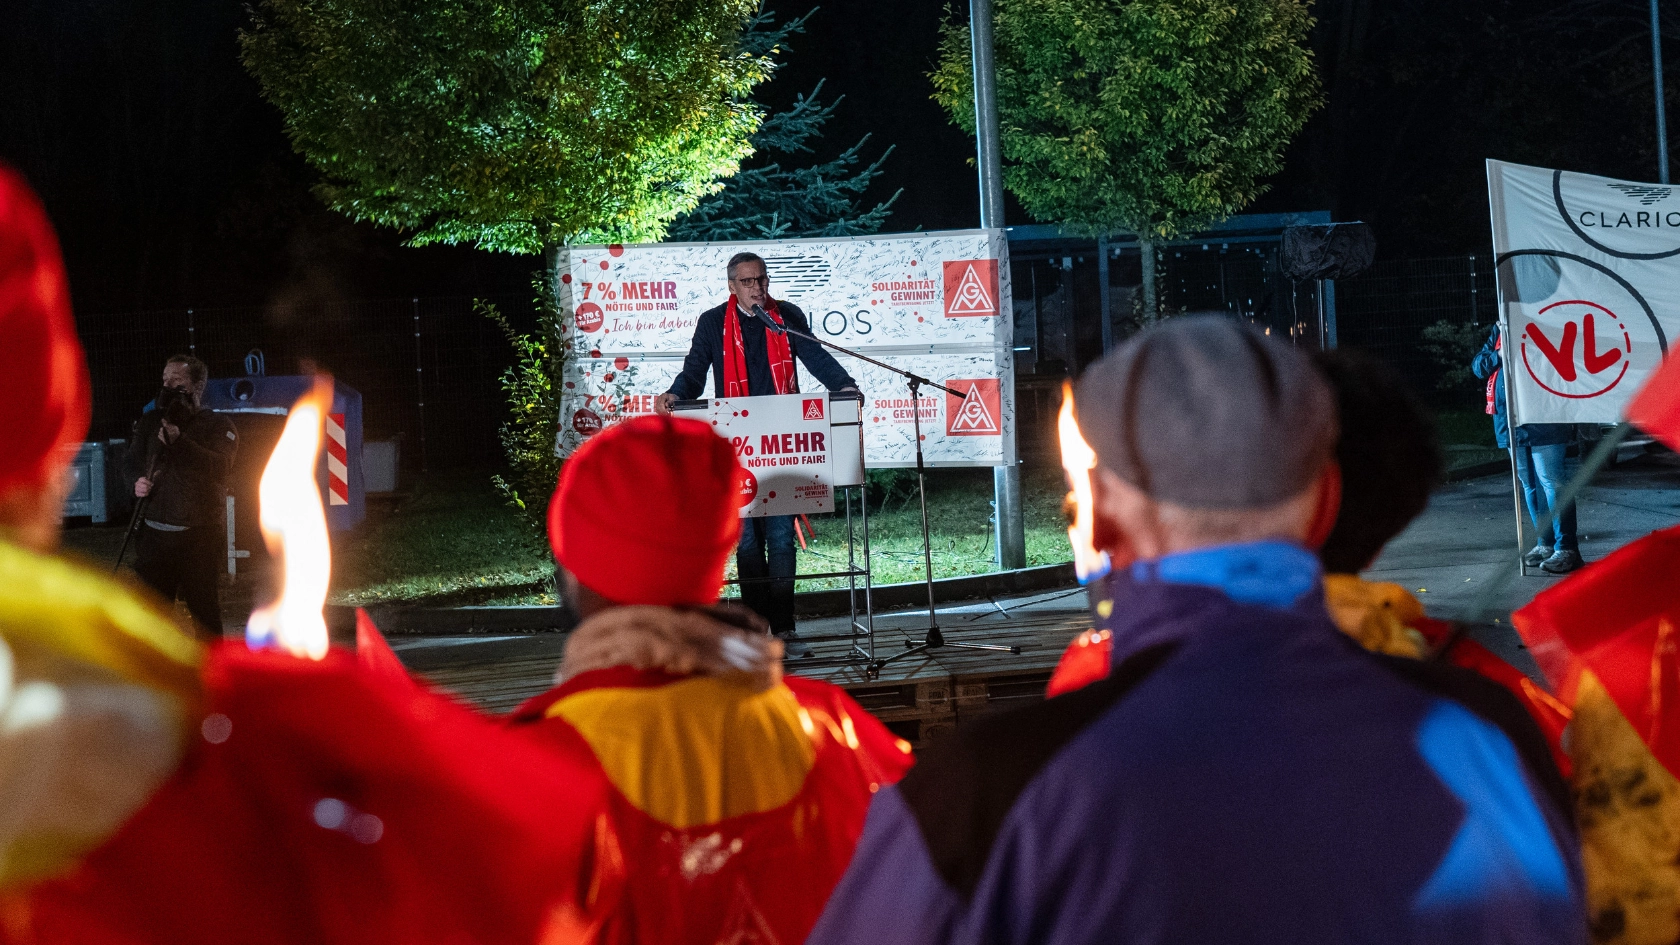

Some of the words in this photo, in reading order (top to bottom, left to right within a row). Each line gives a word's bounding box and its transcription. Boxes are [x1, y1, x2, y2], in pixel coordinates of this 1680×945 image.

[1579, 211, 1680, 228] CLARIO
[581, 282, 593, 300] 7
[598, 281, 617, 300] %
[622, 281, 678, 299] MEHR
[872, 278, 935, 291] SOLIDARITÄT
[891, 291, 935, 301] GEWINNT
[606, 302, 633, 311] NÖTIG
[636, 303, 653, 311] UND
[657, 302, 678, 310] FAIR!
[612, 318, 633, 333] Ich
[635, 319, 656, 332] bin
[659, 316, 698, 329] dabei!
[809, 309, 872, 336] IOS
[1525, 313, 1622, 382] VL
[584, 393, 595, 408] 7
[598, 394, 617, 412] %
[622, 394, 658, 413] ME
[893, 409, 938, 418] GEWNNT
[732, 436, 754, 456] %
[761, 432, 826, 455] MEHR
[747, 456, 777, 468] NÖTIG
[779, 456, 799, 466] UND
[802, 455, 826, 465] FAIR!
[795, 484, 828, 492] SOLIDARITÄT
